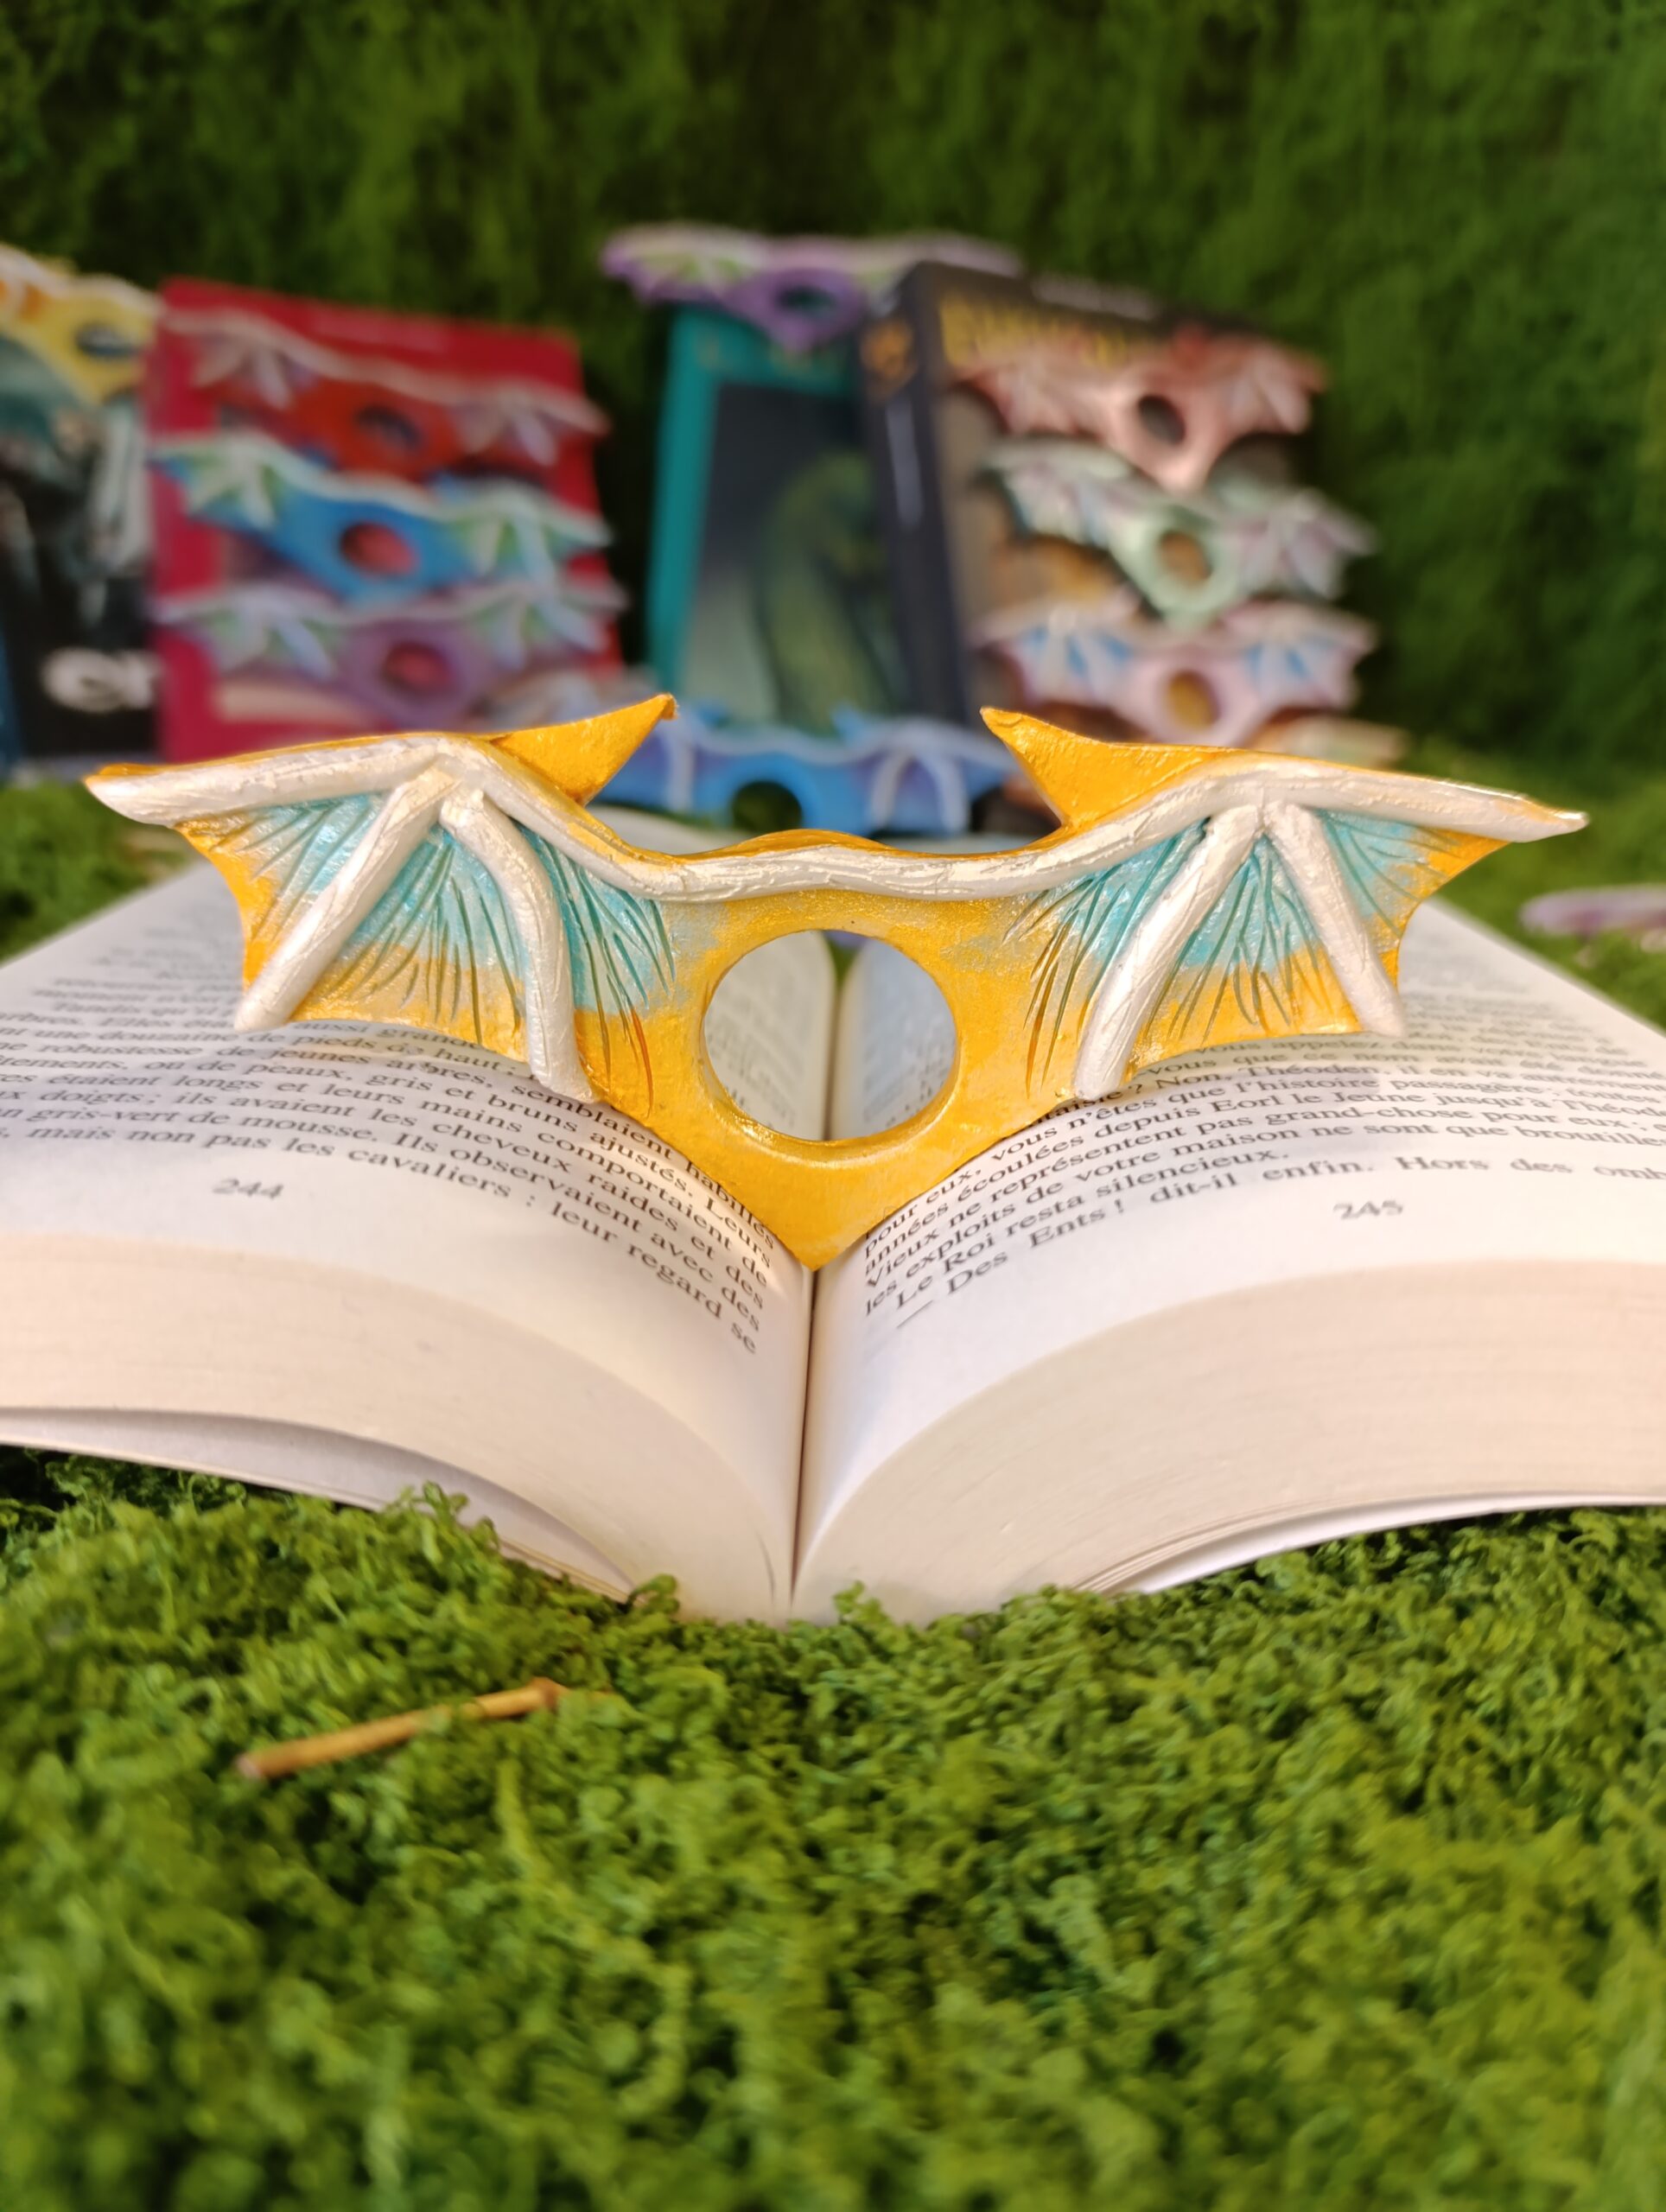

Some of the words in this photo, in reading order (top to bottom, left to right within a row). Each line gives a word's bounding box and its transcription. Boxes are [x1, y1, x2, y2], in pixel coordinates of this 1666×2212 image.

[35, 1028, 91, 1039] une
[98, 1026, 239, 1040] douzaine
[248, 1033, 285, 1042] de
[291, 1035, 378, 1050] pieds
[37, 1043, 204, 1056] robustesse
[215, 1046, 256, 1056] de
[262, 1046, 372, 1065] jeunes
[385, 1058, 493, 1088] arbres,
[512, 1084, 673, 1160] semblaient
[295, 1021, 370, 1033] aussi
[1155, 1072, 1231, 1090] Non,
[1428, 1067, 1468, 1077] en
[1232, 1052, 1288, 1066] que
[1303, 1052, 1339, 1061] ce
[26, 1107, 180, 1122] gris-vert
[187, 1111, 232, 1124] de
[241, 1116, 378, 1141] mousse.
[393, 1132, 439, 1154] Ils
[450, 1149, 643, 1234] observaient
[651, 1231, 714, 1282] avec
[722, 1286, 760, 1332] des
[26, 1126, 116, 1140] mais
[126, 1129, 195, 1143] non
[202, 1133, 271, 1149] pas
[282, 1137, 335, 1156] les
[348, 1148, 511, 1198] cavaliers
[550, 1201, 619, 1242] leur
[627, 1243, 722, 1319] regard
[731, 1322, 756, 1354] se
[47, 1071, 163, 1086] étaient
[172, 1074, 263, 1090] longs
[277, 1081, 309, 1093] et
[321, 1083, 405, 1105] leurs
[419, 1100, 524, 1133] mains
[537, 1132, 732, 1251] comportaient
[741, 1255, 767, 1287] de
[144, 1061, 187, 1071] ou
[196, 1060, 237, 1071] de
[243, 1063, 353, 1080] peaux,
[366, 1074, 434, 1091] gris
[445, 1087, 476, 1100] et
[487, 1095, 578, 1133] bruns
[589, 1131, 693, 1197] ajustés.
[705, 1197, 771, 1268] Leurs
[172, 1091, 217, 1106] ils
[229, 1097, 357, 1117] avaient
[367, 1108, 418, 1127] les
[432, 1123, 573, 1174] cheveux
[586, 1173, 678, 1232] raides
[690, 1236, 715, 1261] et
[725, 1264, 764, 1310] des
[212, 1177, 283, 1200] 244
[864, 1204, 918, 1260] pour
[925, 1169, 982, 1205] eux,
[991, 1128, 1058, 1162] vous
[1068, 1097, 1157, 1130] n'êtes
[1167, 1087, 1225, 1103] que
[1235, 1077, 1381, 1093] l'histoire
[864, 1202, 949, 1276] années
[957, 1135, 1084, 1203] écoulées
[1094, 1106, 1200, 1139] depuis
[1211, 1095, 1283, 1113] Eorl
[1291, 1093, 1322, 1105] le
[1333, 1092, 1427, 1103] Jeune
[865, 1229, 940, 1288] Vieux
[949, 1202, 982, 1228] ne
[991, 1126, 1187, 1204] représentent
[1196, 1117, 1254, 1136] pas
[1264, 1107, 1472, 1126] grand-chose
[1480, 1112, 1562, 1123] pour
[865, 1280, 898, 1317] les
[906, 1204, 1015, 1279] exploits
[1026, 1180, 1064, 1205] de
[1075, 1151, 1160, 1182] votre
[1172, 1127, 1300, 1157] maison
[1310, 1125, 1353, 1137] ne
[1363, 1123, 1439, 1135] sont
[1446, 1124, 1510, 1137] que
[896, 1274, 933, 1310] Le
[944, 1232, 995, 1274] Roi
[1005, 1195, 1084, 1237] resta
[1096, 1149, 1289, 1198] silencieux.
[947, 1250, 1008, 1295] Des
[1150, 1172, 1238, 1205] dit-il
[1262, 1160, 1375, 1182] enfin.
[1394, 1156, 1491, 1171] Hors
[1510, 1158, 1574, 1174] des
[1333, 1198, 1404, 1222] 245
